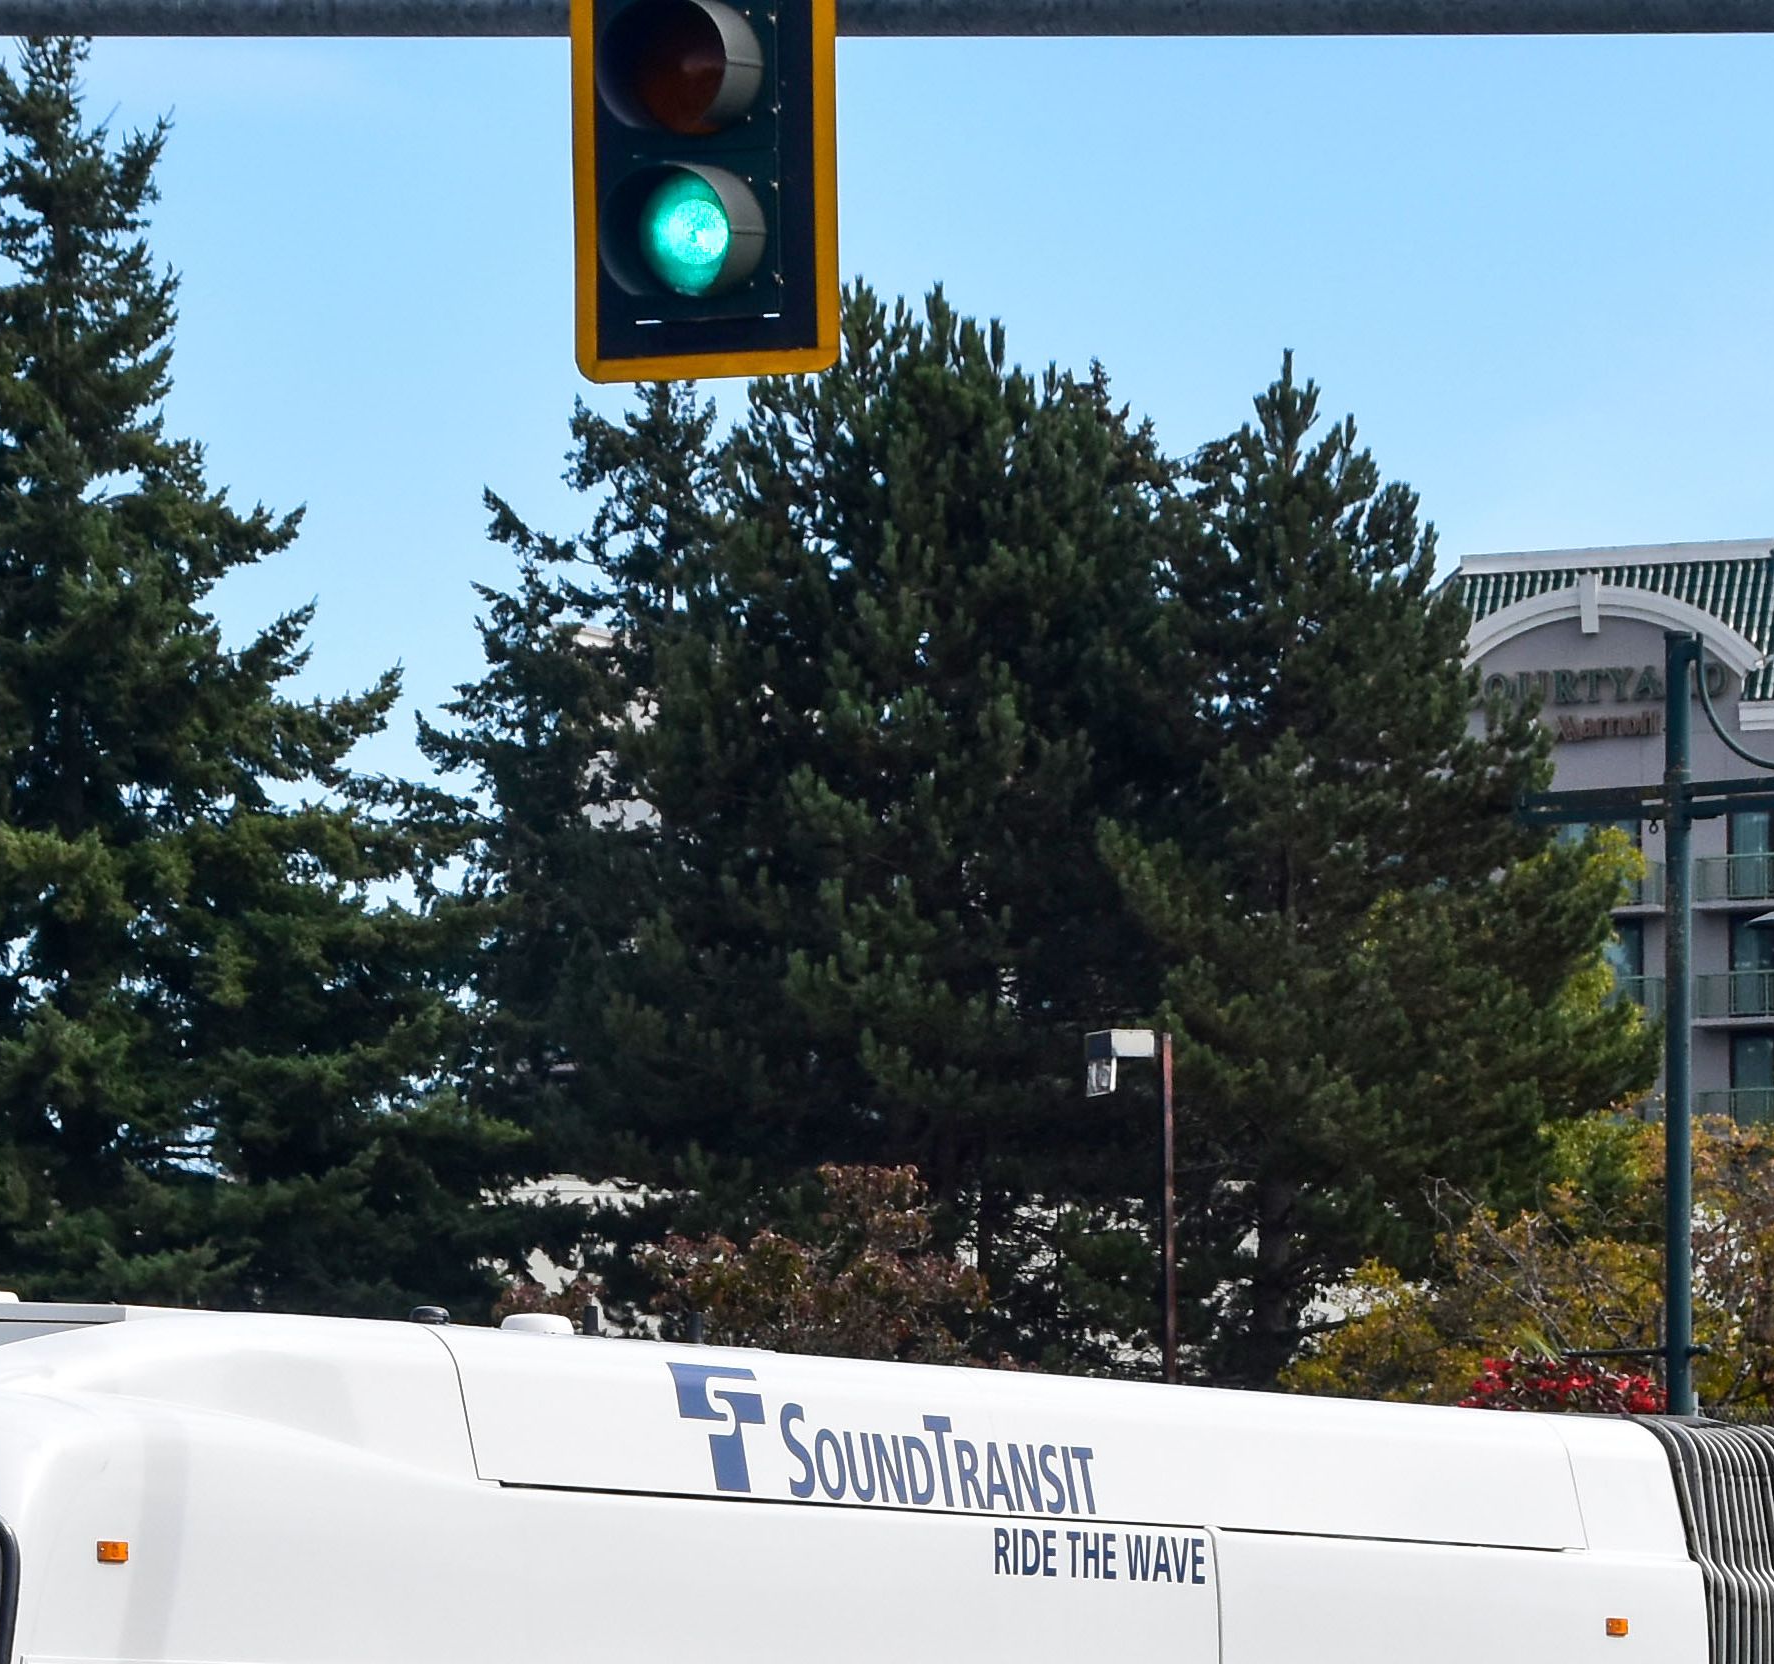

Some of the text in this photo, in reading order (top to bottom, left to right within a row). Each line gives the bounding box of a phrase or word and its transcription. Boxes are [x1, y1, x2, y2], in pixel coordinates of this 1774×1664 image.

[1482, 664, 1731, 705] OURTYAD
[993, 1527, 1205, 1585] RIDE THE WAVE
